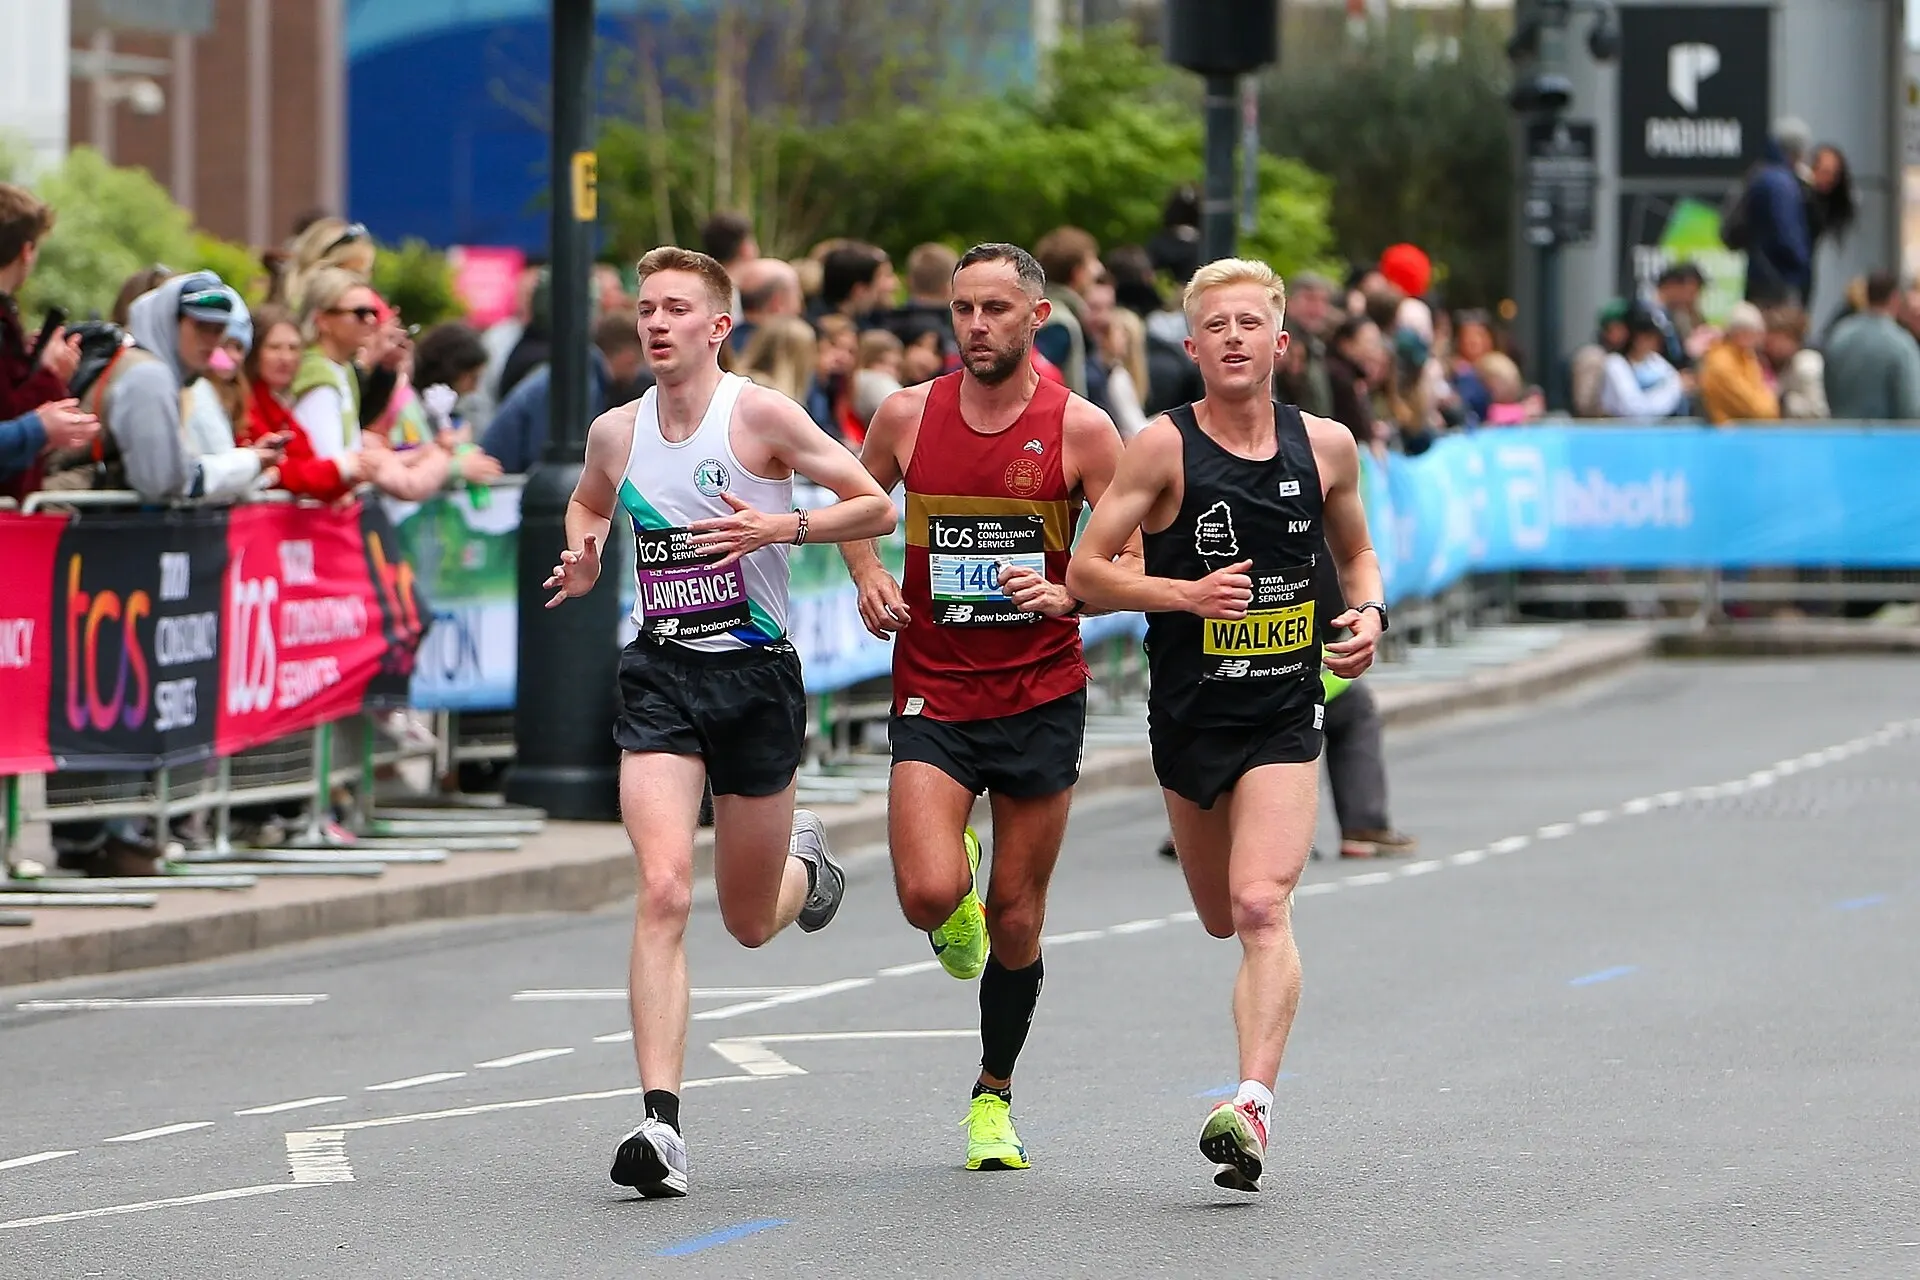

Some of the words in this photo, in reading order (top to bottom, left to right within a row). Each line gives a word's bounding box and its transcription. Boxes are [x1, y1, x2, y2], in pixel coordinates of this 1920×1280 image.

[935, 520, 974, 548] tcs
[977, 522, 1002, 530] TATA
[1288, 519, 1311, 533] KW
[977, 530, 1036, 540] CONSULTANCY
[638, 535, 668, 563] tcs
[977, 540, 1015, 549] SERVICES
[1258, 575, 1284, 585] TATA
[1258, 578, 1310, 594] CONSULTANCY
[643, 571, 740, 611] LAWRENCE
[1258, 592, 1294, 604] SERVICES
[974, 614, 994, 622] new
[995, 612, 1034, 622] balance
[680, 626, 700, 636] new
[700, 618, 741, 632] balance
[1211, 616, 1308, 650] WALKER
[66, 552, 151, 731] tcs
[1250, 667, 1271, 678] new
[1271, 661, 1303, 676] balance
